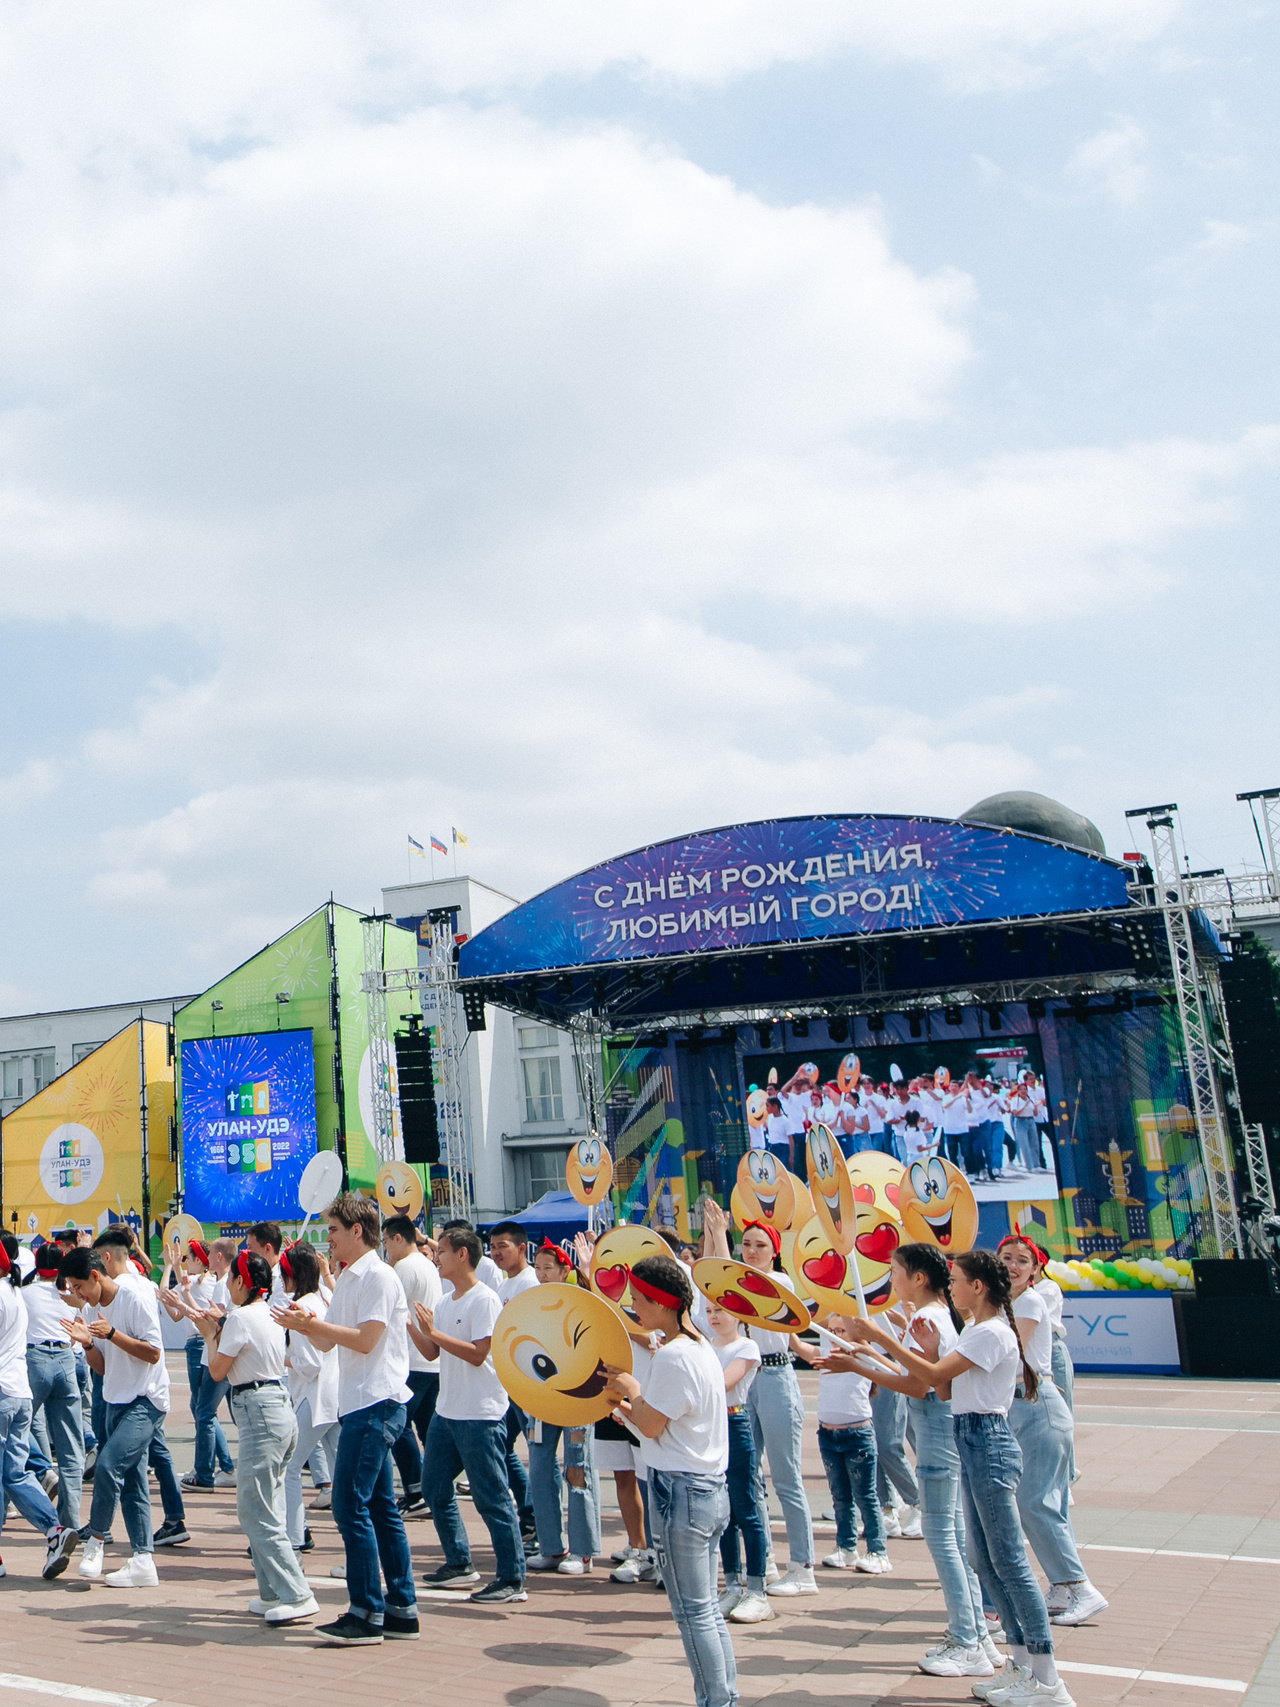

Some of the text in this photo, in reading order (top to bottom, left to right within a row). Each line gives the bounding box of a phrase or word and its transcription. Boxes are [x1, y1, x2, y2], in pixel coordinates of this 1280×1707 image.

[594, 843, 932, 909] С ДНЁМ РОЖДЕНИЯ,
[606, 883, 921, 942] ЛЮБИМЫЙ ГОРОД!
[207, 1117, 290, 1137] УЛАН-УДЭ
[228, 1142, 271, 1165] 356
[272, 1141, 290, 1151] 2022
[51, 1158, 91, 1168] УЛАН-УДЭ
